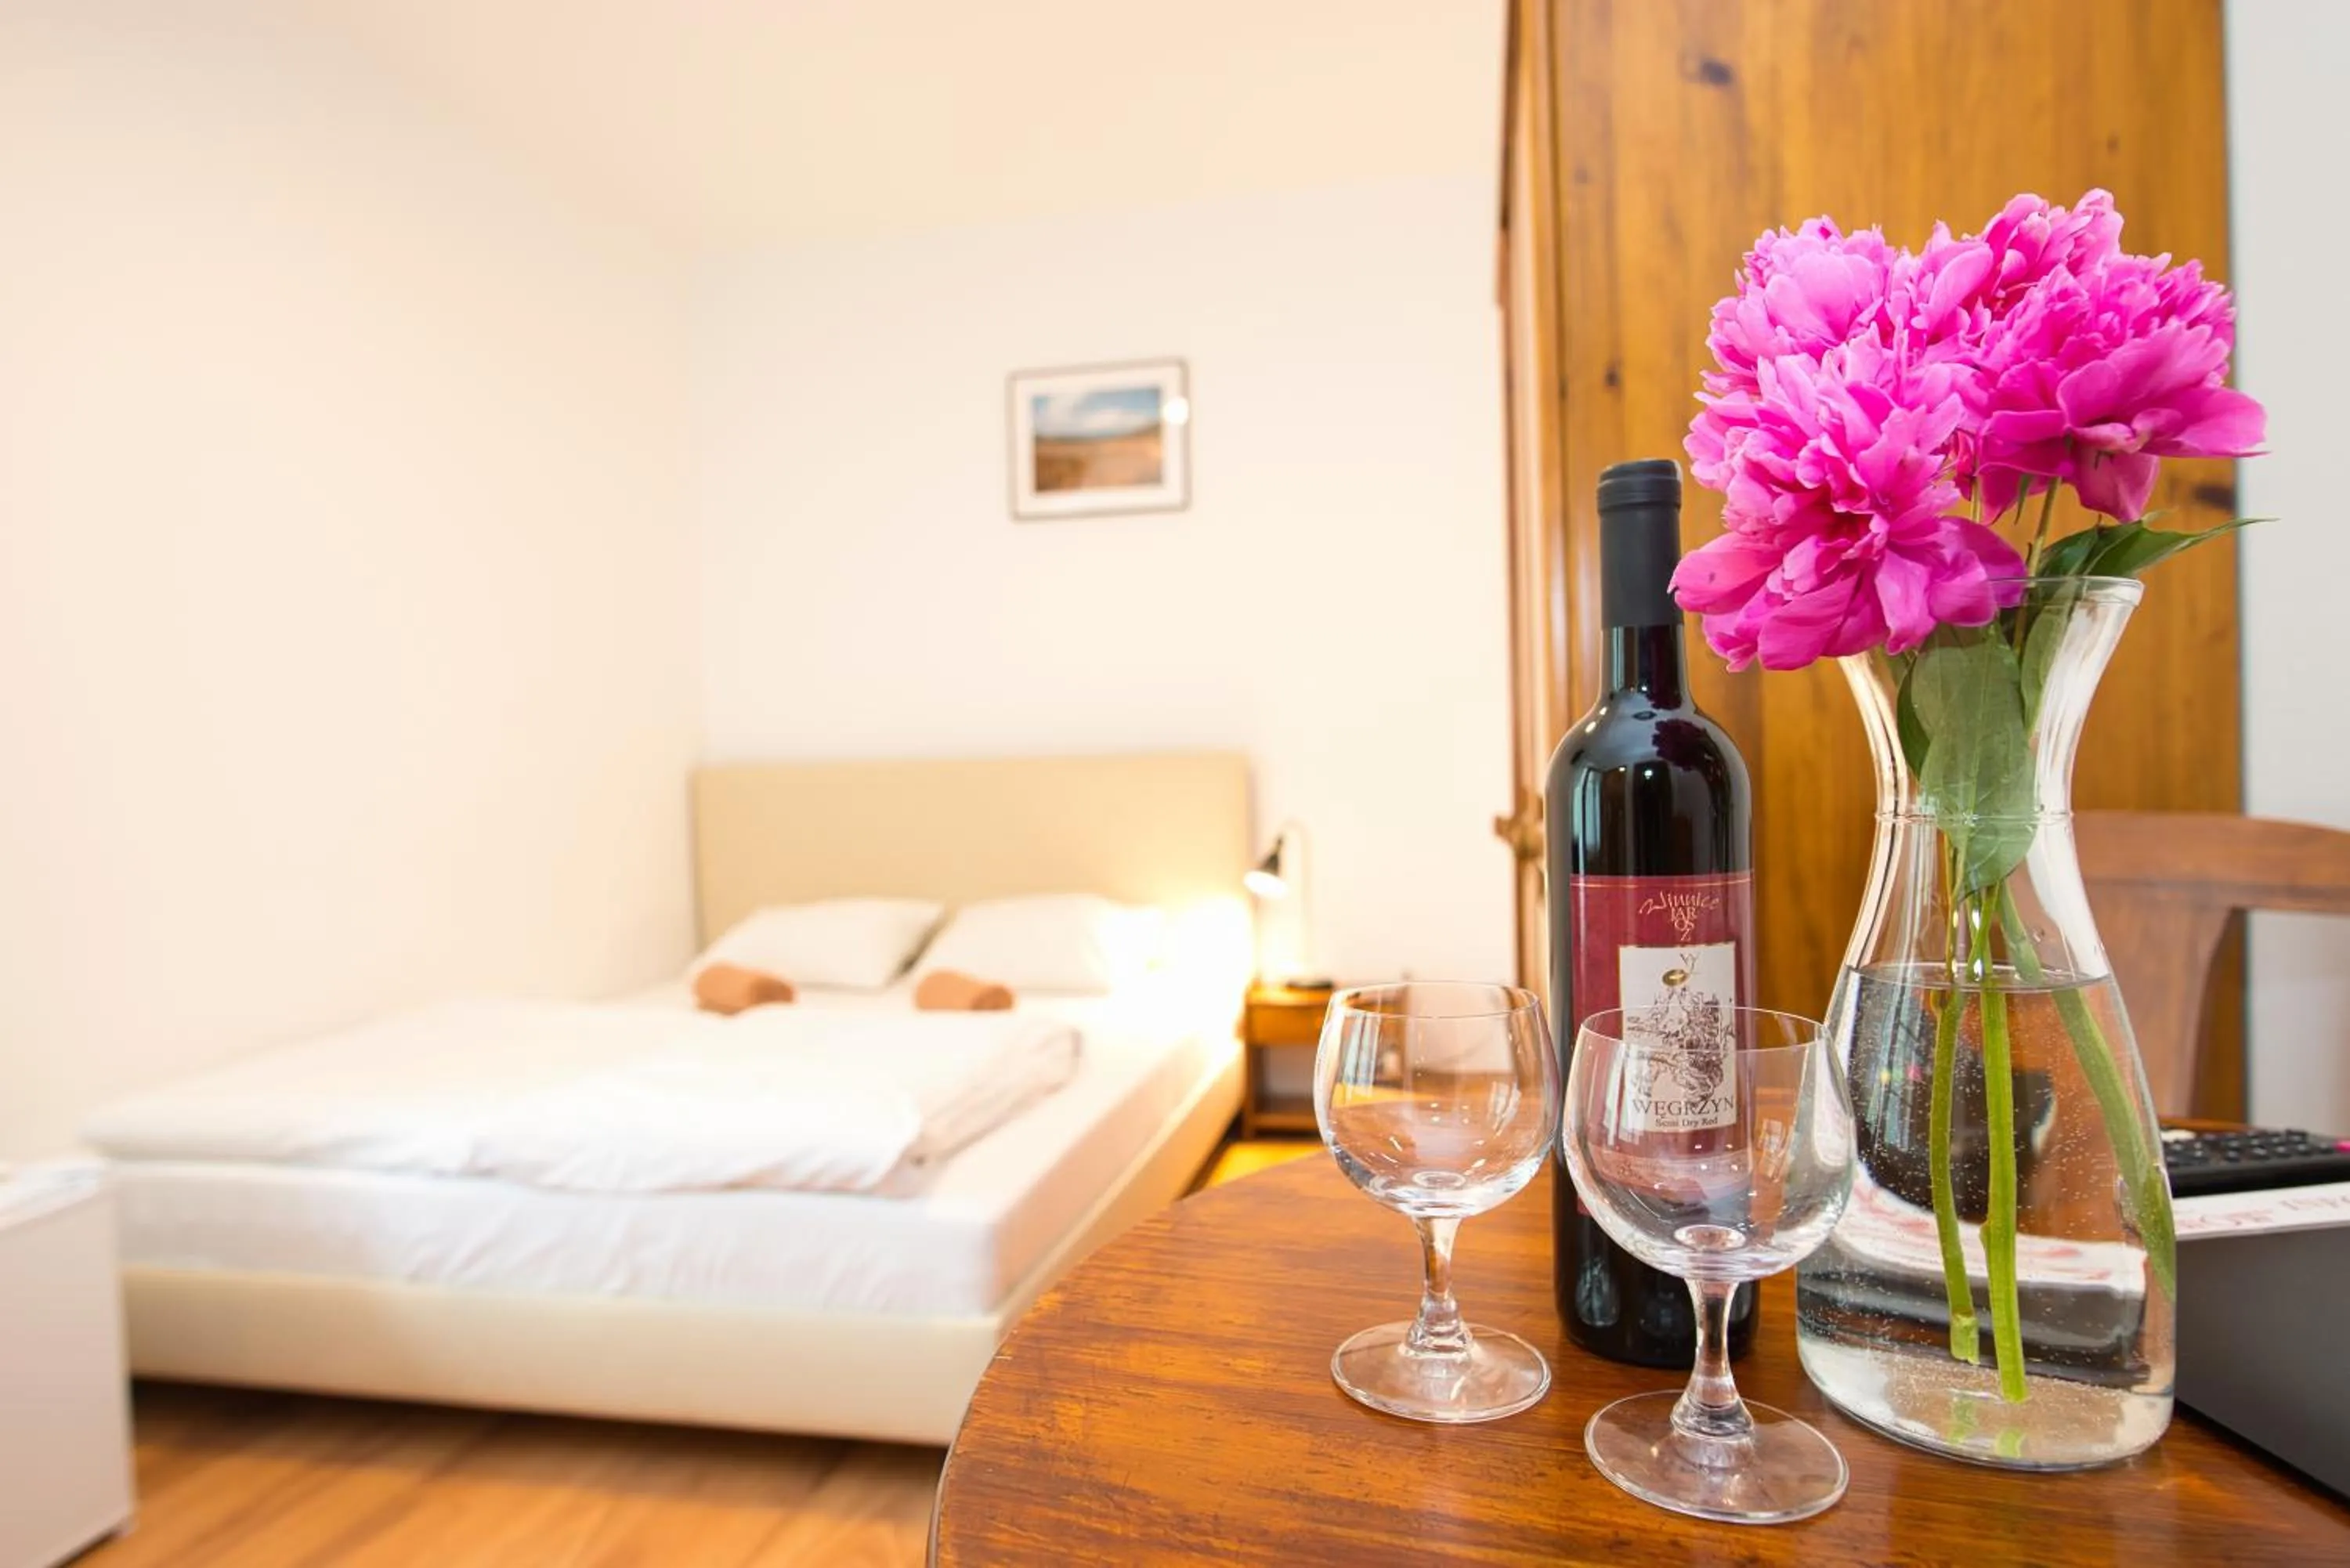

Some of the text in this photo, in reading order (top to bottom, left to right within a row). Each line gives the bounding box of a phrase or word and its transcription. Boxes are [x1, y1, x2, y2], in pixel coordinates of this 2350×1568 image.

[1632, 1096, 1734, 1119] WĘGRZYN
[1655, 1117, 1718, 1128] Semi Dry Red
